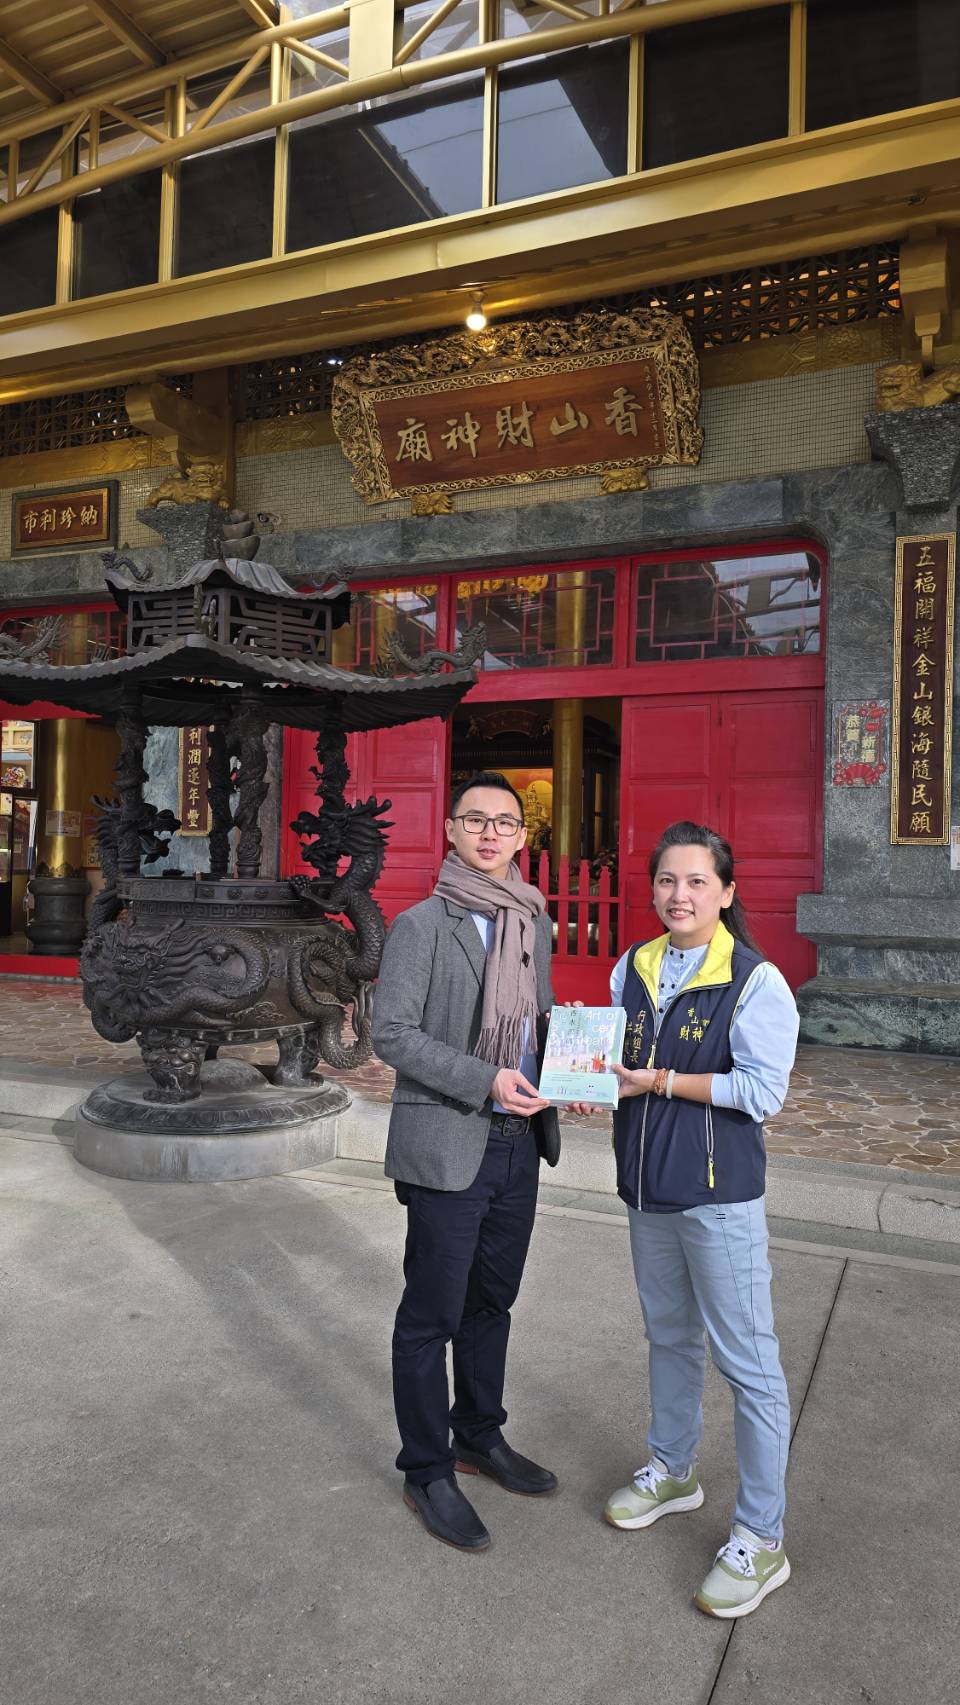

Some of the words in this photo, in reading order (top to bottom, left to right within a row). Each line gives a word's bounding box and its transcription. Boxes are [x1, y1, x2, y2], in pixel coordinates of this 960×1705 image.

[394, 387, 642, 462] 香山財神廟
[23, 505, 99, 534] 納珍利市
[910, 546, 936, 834] 五福開祥金山銀海隨民願
